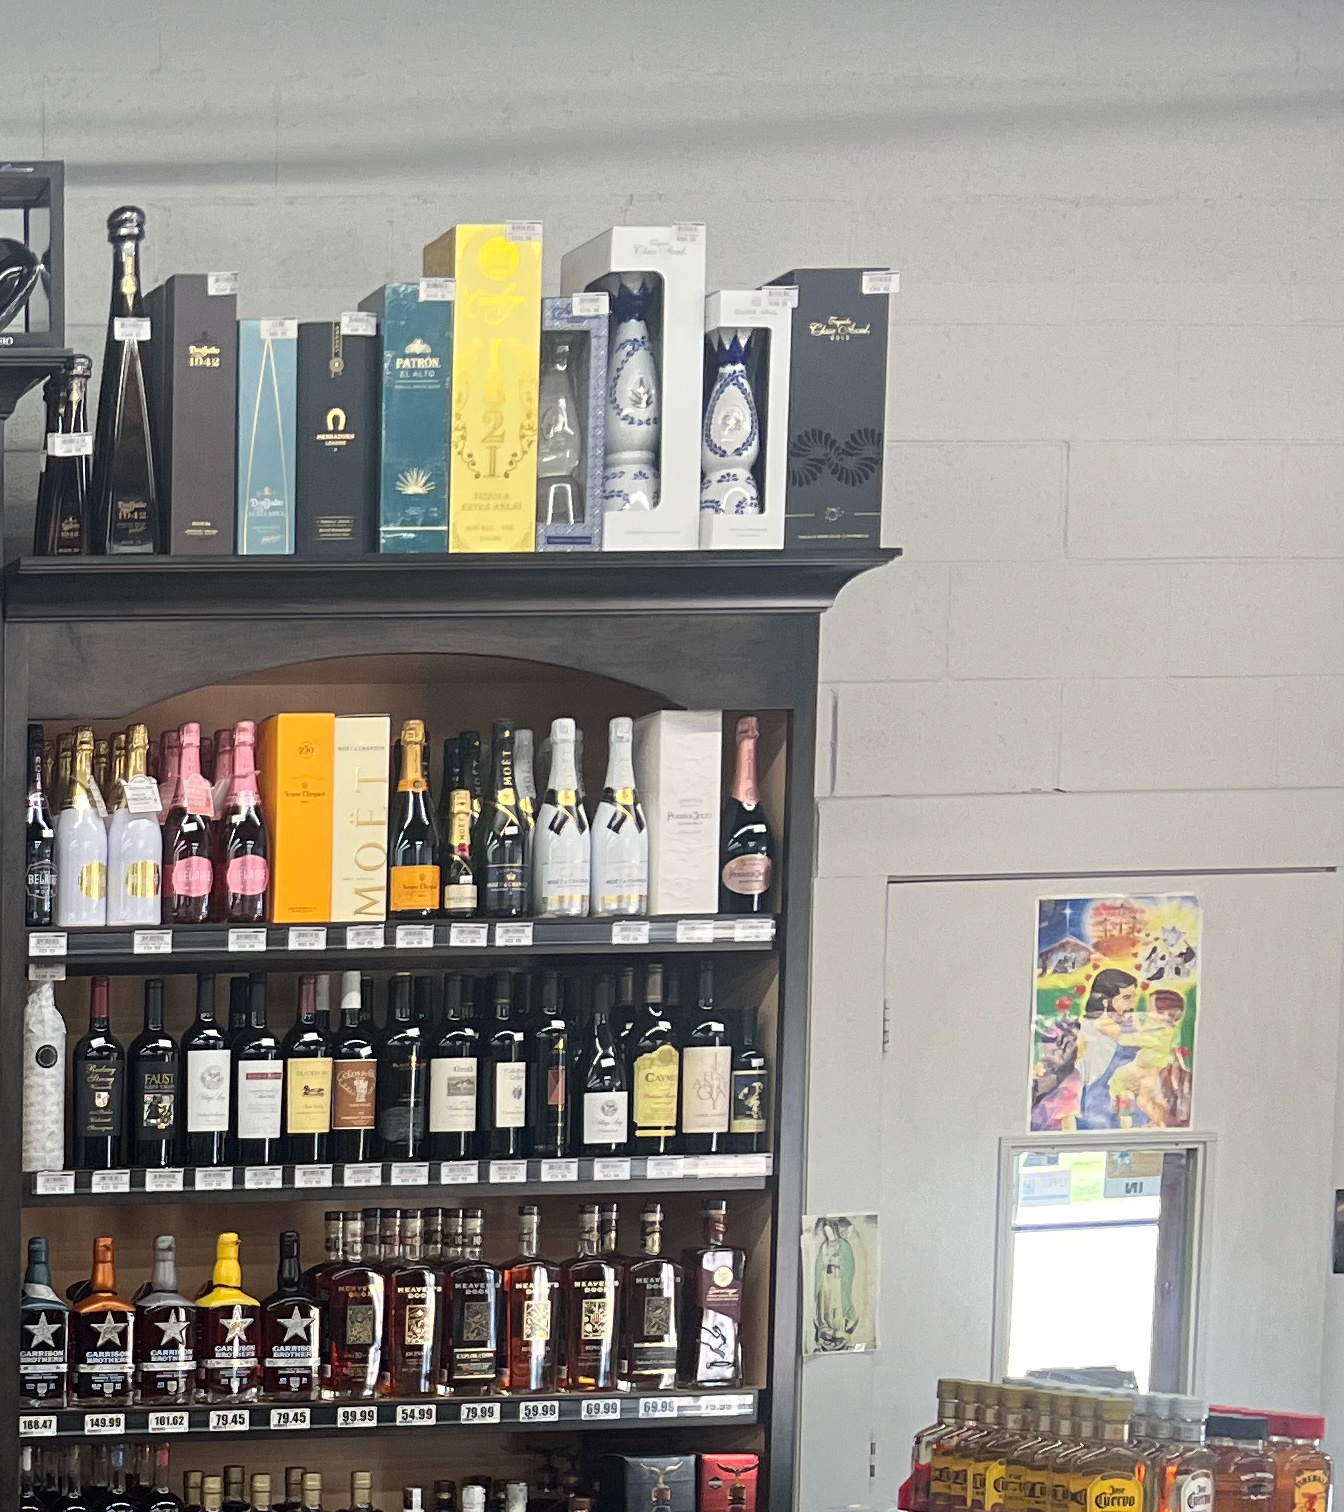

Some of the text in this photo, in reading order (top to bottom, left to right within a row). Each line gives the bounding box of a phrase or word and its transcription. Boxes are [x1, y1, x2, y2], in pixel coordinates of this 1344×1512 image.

[353, 766, 387, 917] MOËT
[145, 1073, 174, 1084] FAUST
[524, 1405, 555, 1417] 59.99
[276, 1412, 306, 1423] 79.45
[1095, 1493, 1135, 1508] Cuervo
